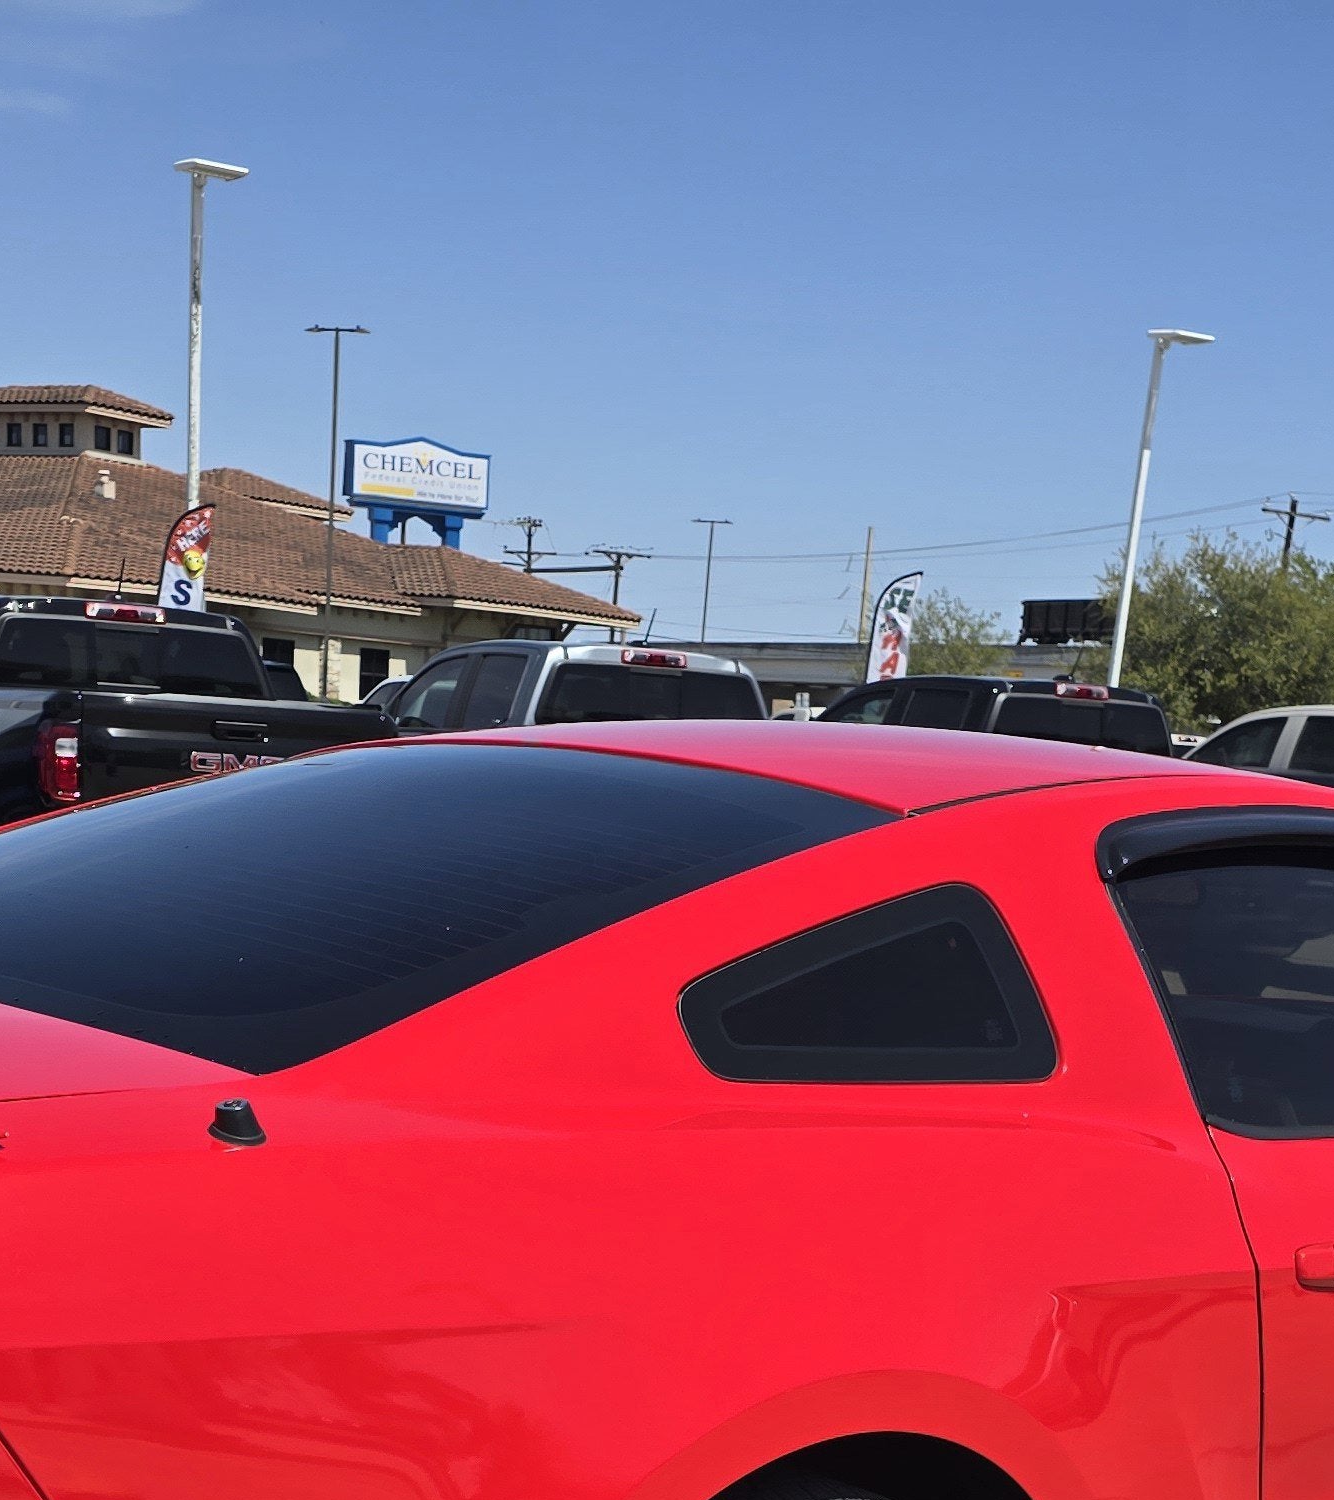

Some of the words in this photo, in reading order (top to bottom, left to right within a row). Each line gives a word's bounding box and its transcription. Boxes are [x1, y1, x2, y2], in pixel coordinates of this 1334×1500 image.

[363, 452, 481, 480] CHEMCEL
[363, 471, 405, 483] Federal
[411, 477, 444, 487] Credit
[449, 481, 479, 490] Union
